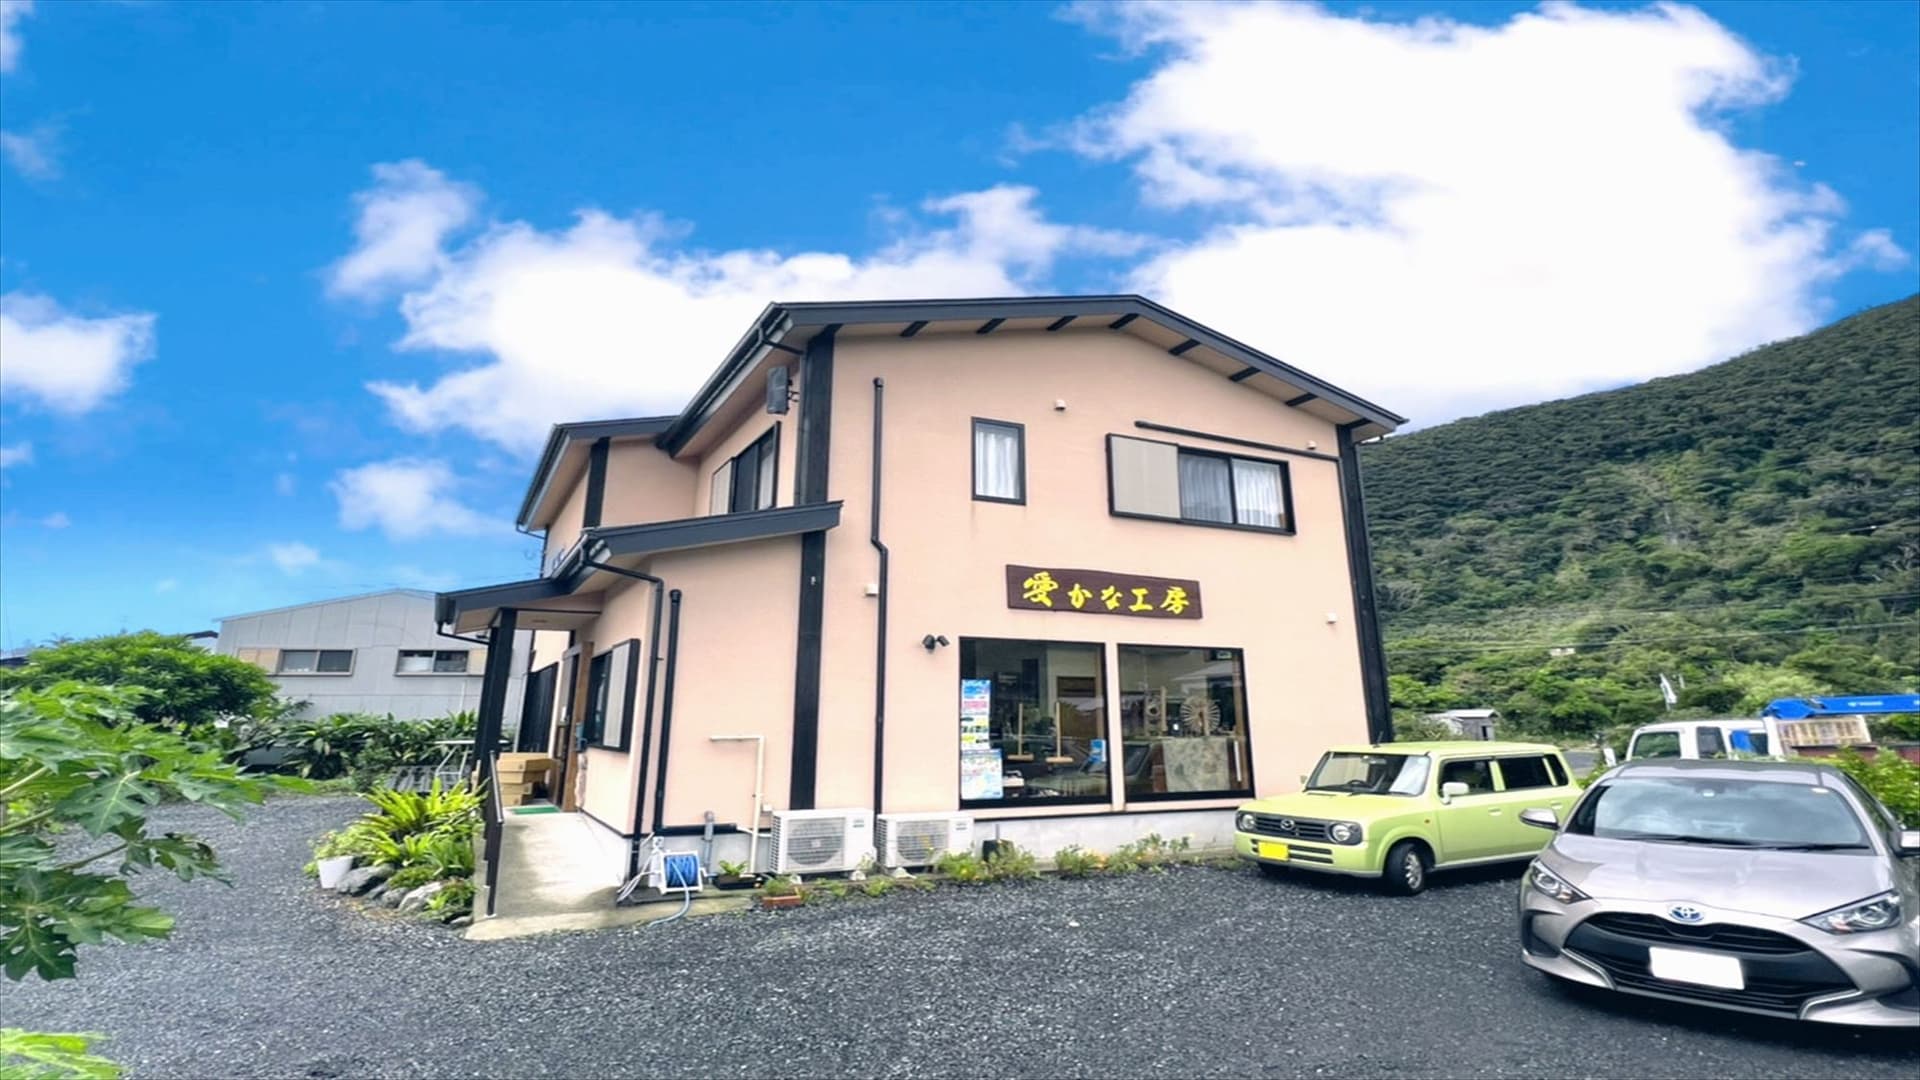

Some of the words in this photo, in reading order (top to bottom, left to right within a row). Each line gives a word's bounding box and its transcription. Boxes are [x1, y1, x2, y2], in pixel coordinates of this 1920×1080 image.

[1022, 571, 1190, 615] 愛かな工房
